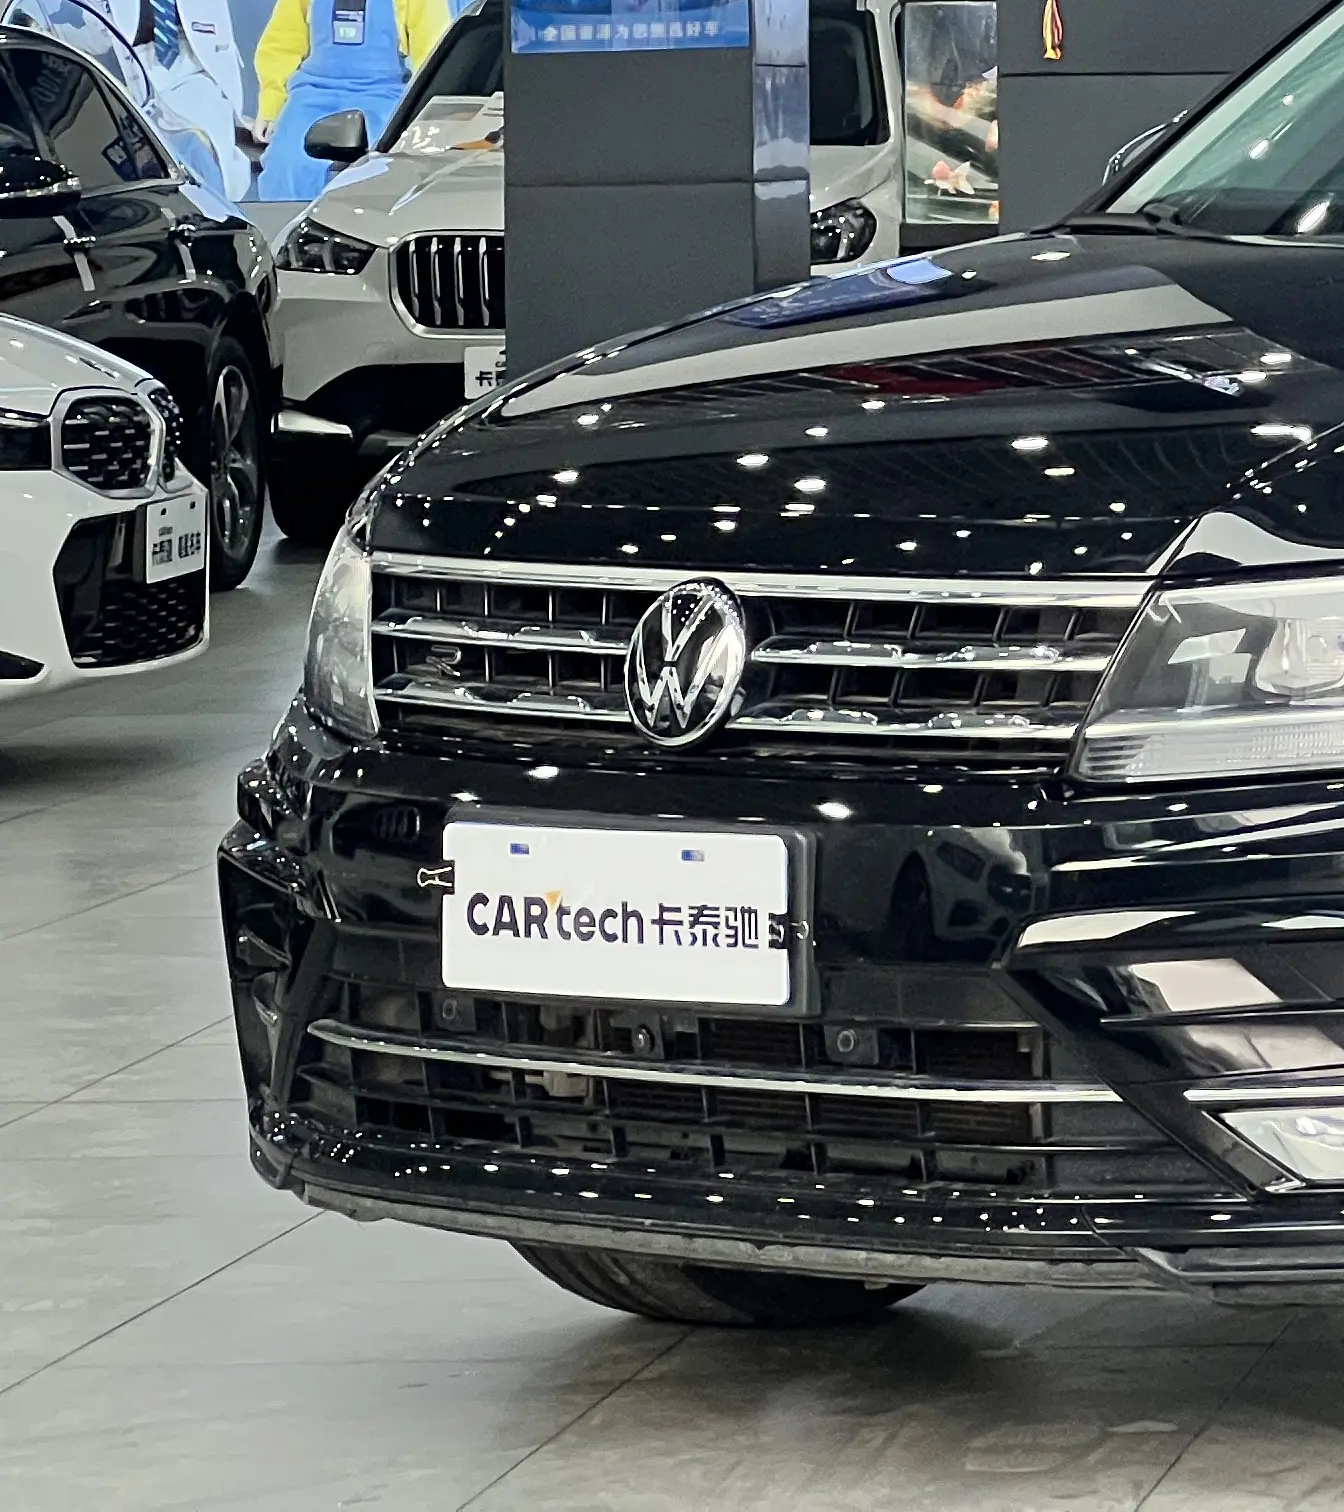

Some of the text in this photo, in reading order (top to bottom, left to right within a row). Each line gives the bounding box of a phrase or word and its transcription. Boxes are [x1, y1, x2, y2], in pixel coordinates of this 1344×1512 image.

[466, 891, 760, 949] CARtech 卡泰驰
